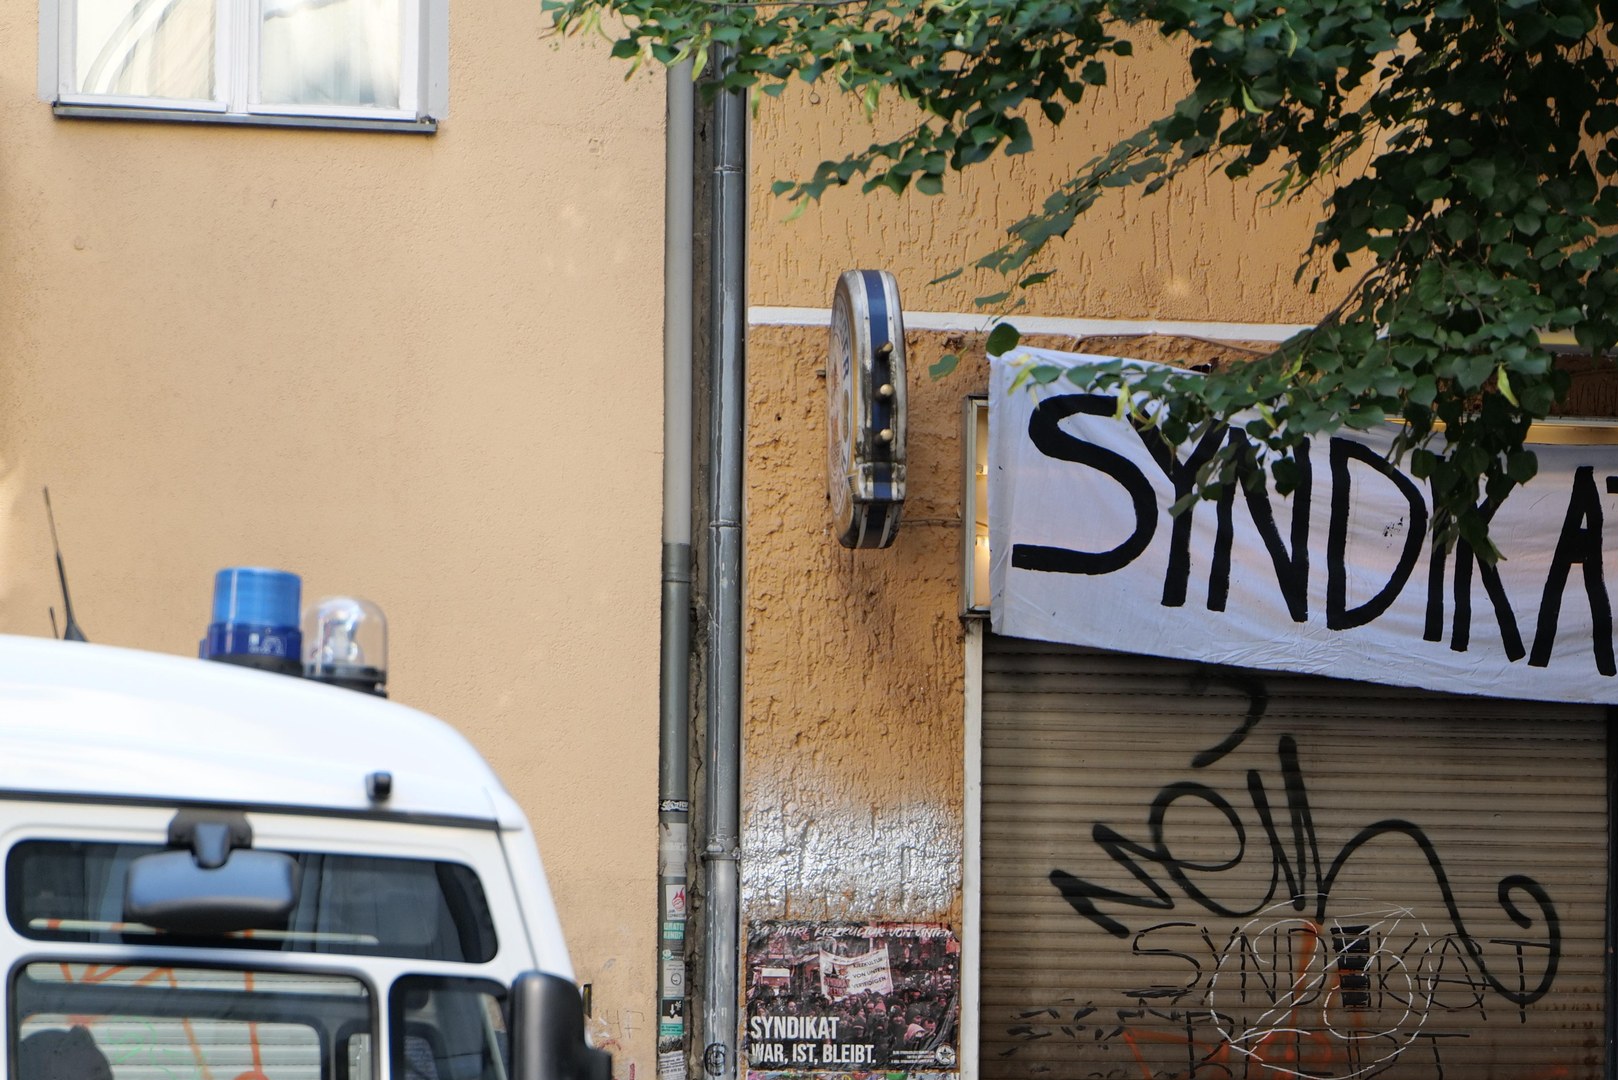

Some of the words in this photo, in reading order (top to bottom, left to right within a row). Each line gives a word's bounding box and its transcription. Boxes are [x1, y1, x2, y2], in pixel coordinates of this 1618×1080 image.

[890, 927, 912, 937] VON
[751, 1017, 839, 1039] SYNDIKAT
[751, 1044, 788, 1064] WAR,
[793, 1044, 819, 1065] IST,
[823, 1044, 876, 1063] BLEIBT.
